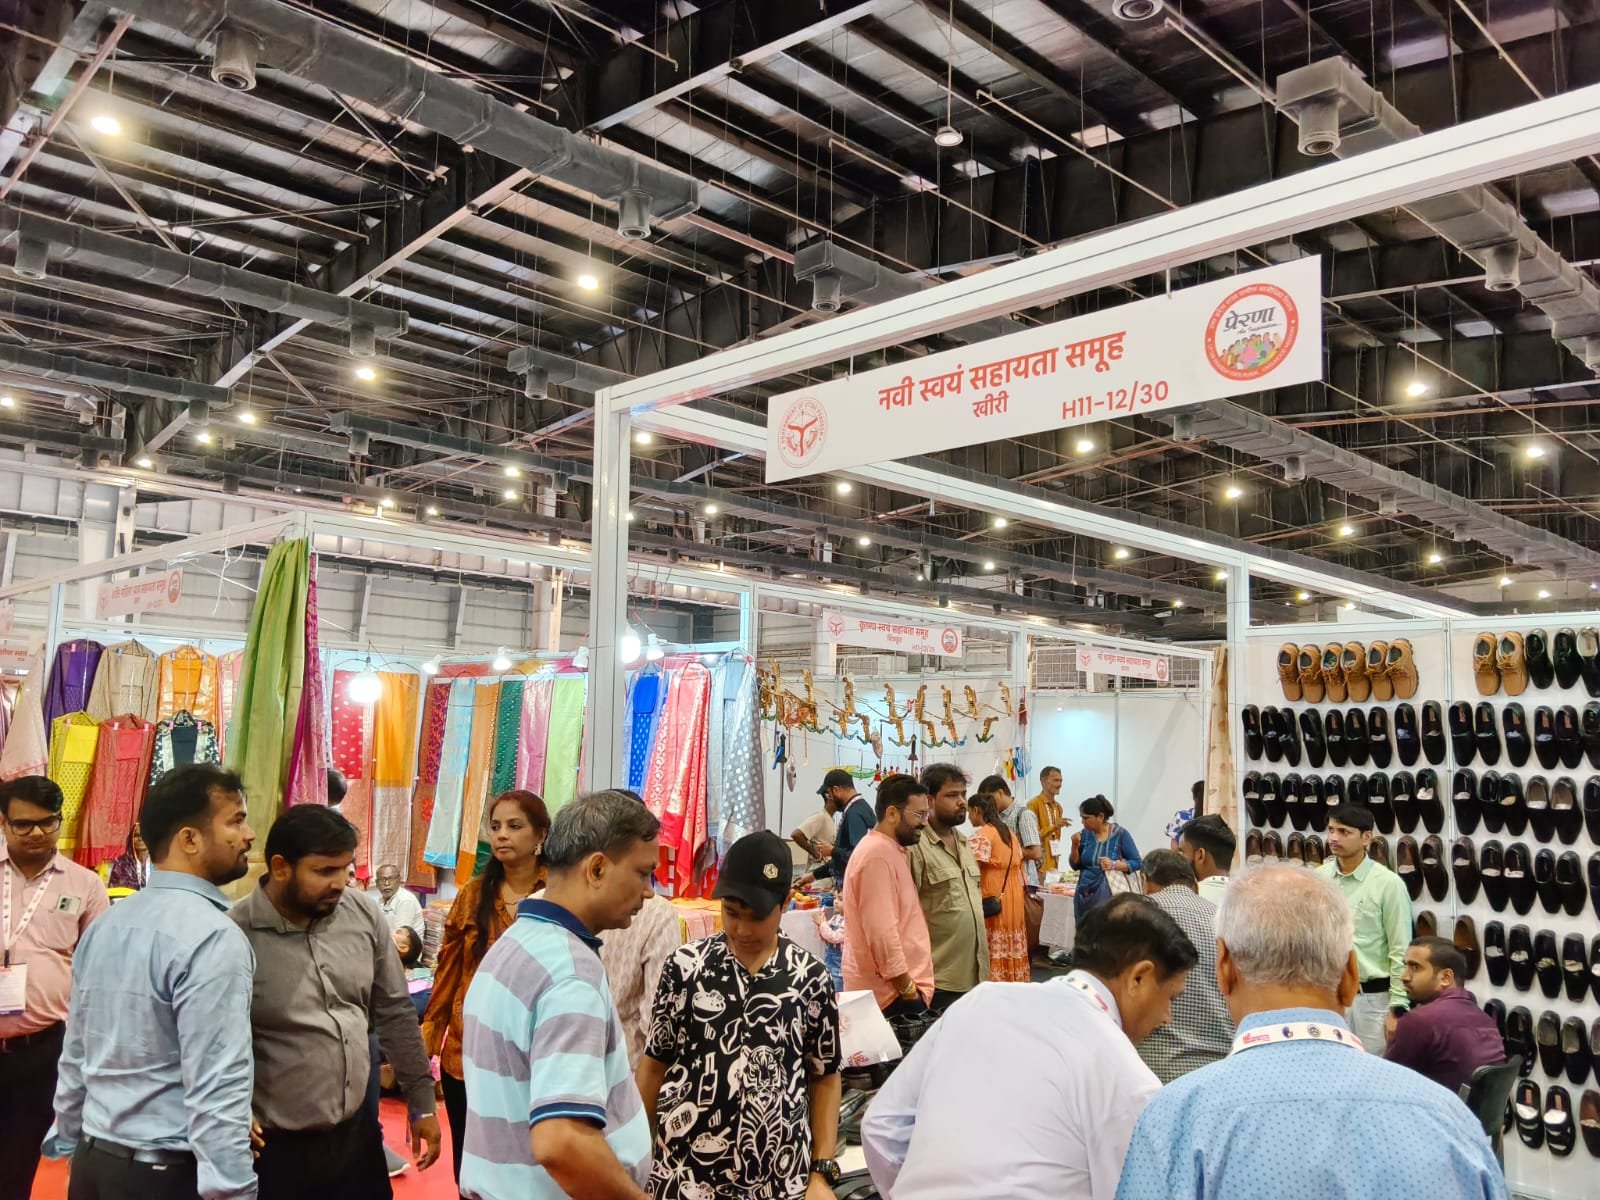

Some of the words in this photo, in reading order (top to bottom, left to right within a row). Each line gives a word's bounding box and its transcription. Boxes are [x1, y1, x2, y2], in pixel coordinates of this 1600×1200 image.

[1224, 310, 1277, 332] प्रेरणा
[879, 376, 915, 410] नवी
[920, 365, 966, 402] स्वयं
[970, 348, 1059, 391] सहायता
[1065, 331, 1126, 373] समूह
[974, 390, 1009, 417] खीरी
[1062, 381, 1168, 419] H11-12/30
